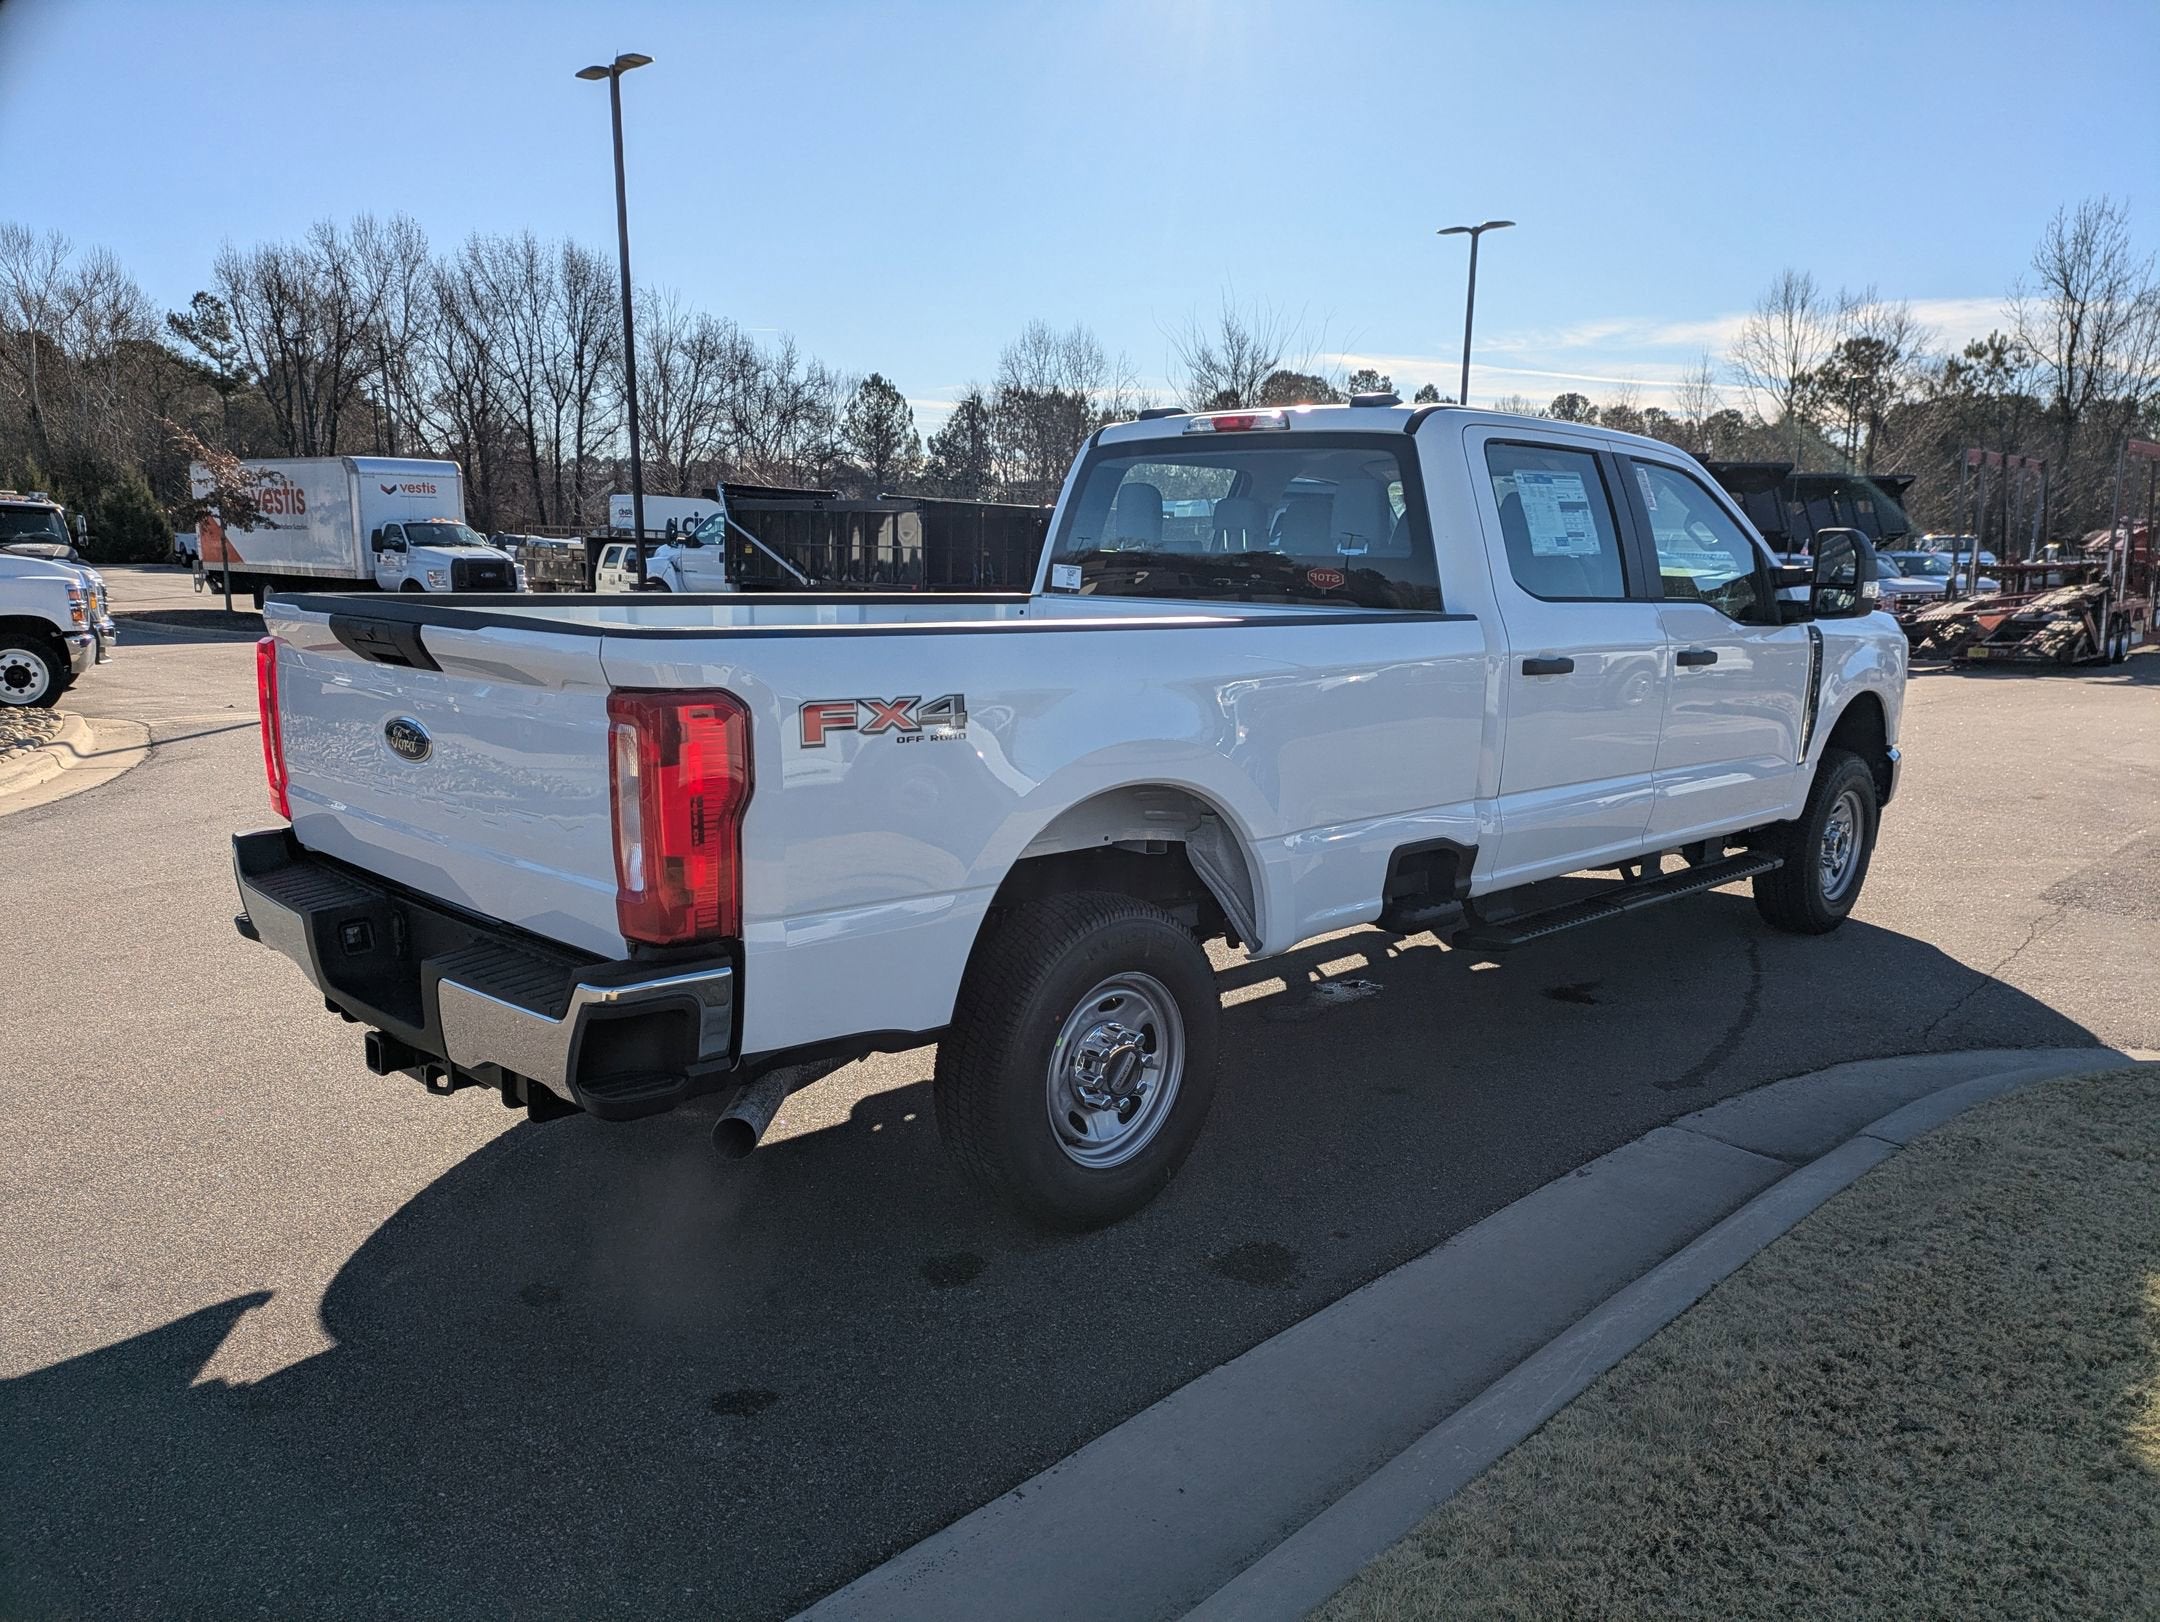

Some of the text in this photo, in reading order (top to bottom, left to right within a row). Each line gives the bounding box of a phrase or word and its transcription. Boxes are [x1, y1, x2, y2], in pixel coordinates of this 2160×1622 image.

[251, 480, 306, 515] vestis
[400, 482, 437, 494] vestis
[799, 694, 967, 749] FX4
[896, 735, 925, 744] OFF
